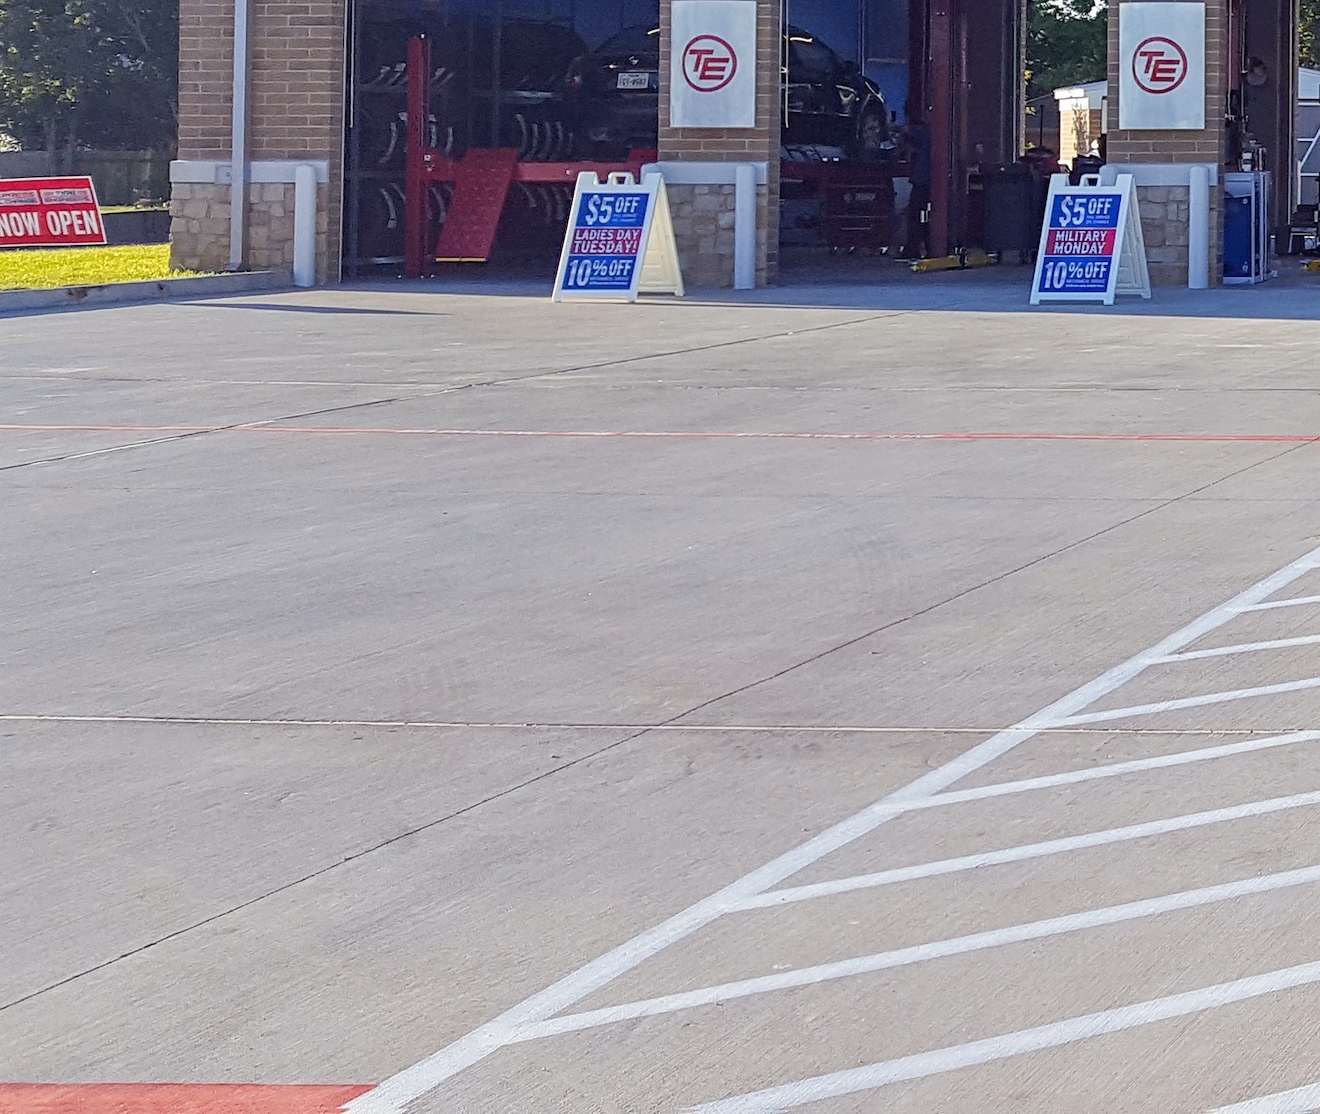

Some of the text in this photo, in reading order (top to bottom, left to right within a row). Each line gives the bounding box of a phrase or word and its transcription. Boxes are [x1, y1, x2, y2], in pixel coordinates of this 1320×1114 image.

[0, 210, 99, 237] NOW OPEN
[585, 194, 640, 226] $5 OFF
[1058, 196, 1113, 227] $5 OFF
[573, 240, 638, 254] TUESDAY!
[575, 229, 640, 240] LADIES DAY
[1053, 241, 1107, 255] MONDAY
[1055, 231, 1108, 242] MILITARY
[567, 259, 608, 286] 10%
[608, 259, 633, 276] OFF
[1043, 261, 1084, 289] 10%
[1084, 261, 1109, 279] OFF
